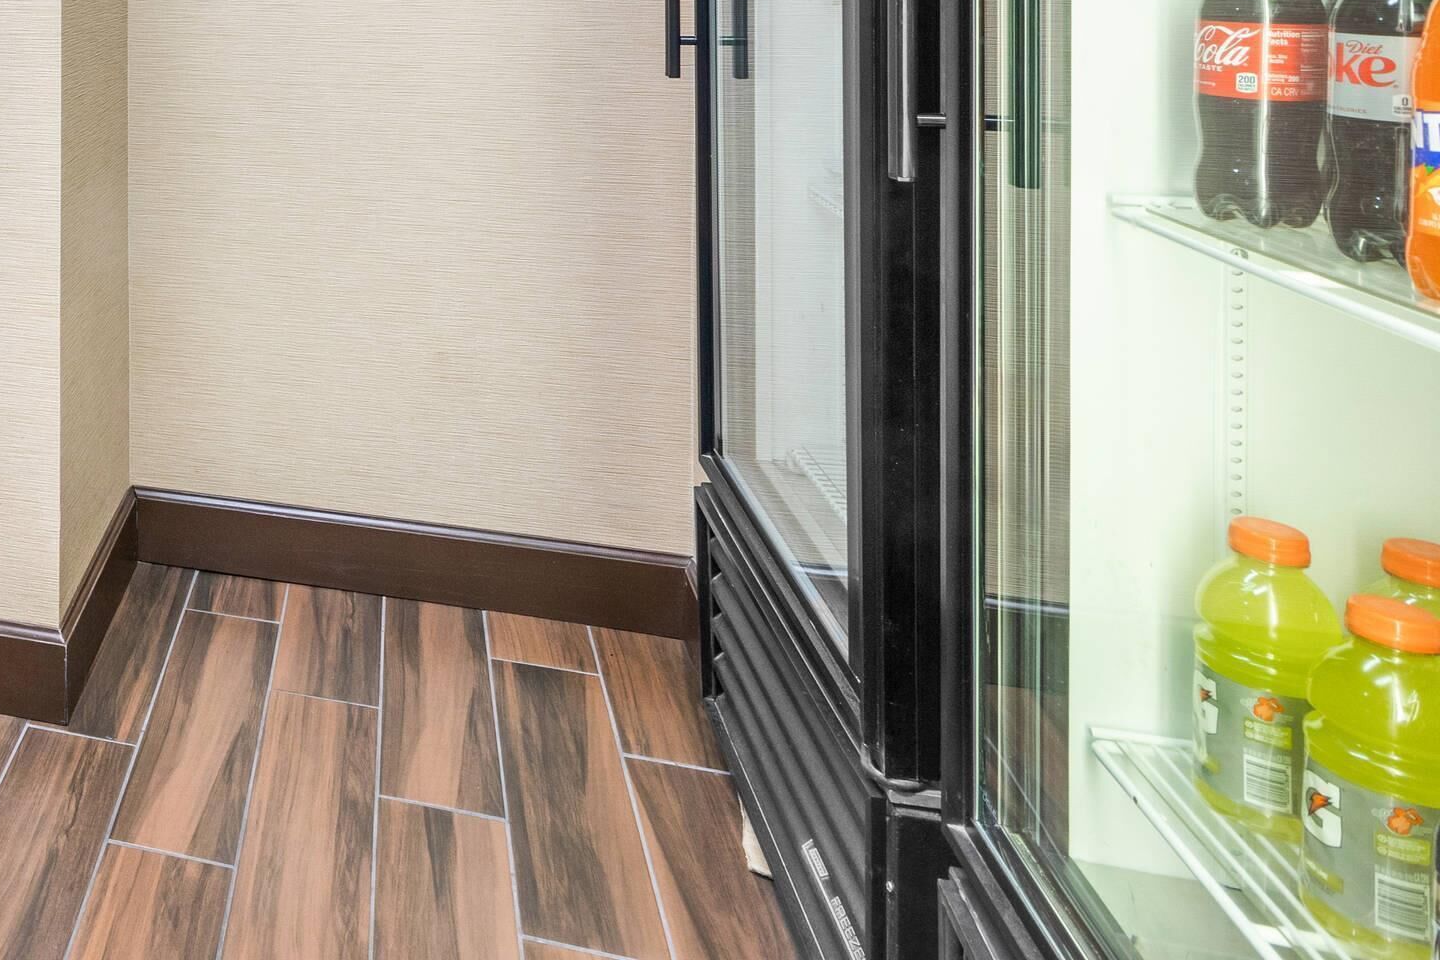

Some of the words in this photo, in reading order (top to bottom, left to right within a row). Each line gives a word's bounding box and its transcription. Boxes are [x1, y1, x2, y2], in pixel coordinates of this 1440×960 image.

[1195, 25, 1260, 66] Cola
[1346, 40, 1383, 55] Diet
[1238, 75, 1256, 84] 200
[1271, 87, 1282, 96] CA
